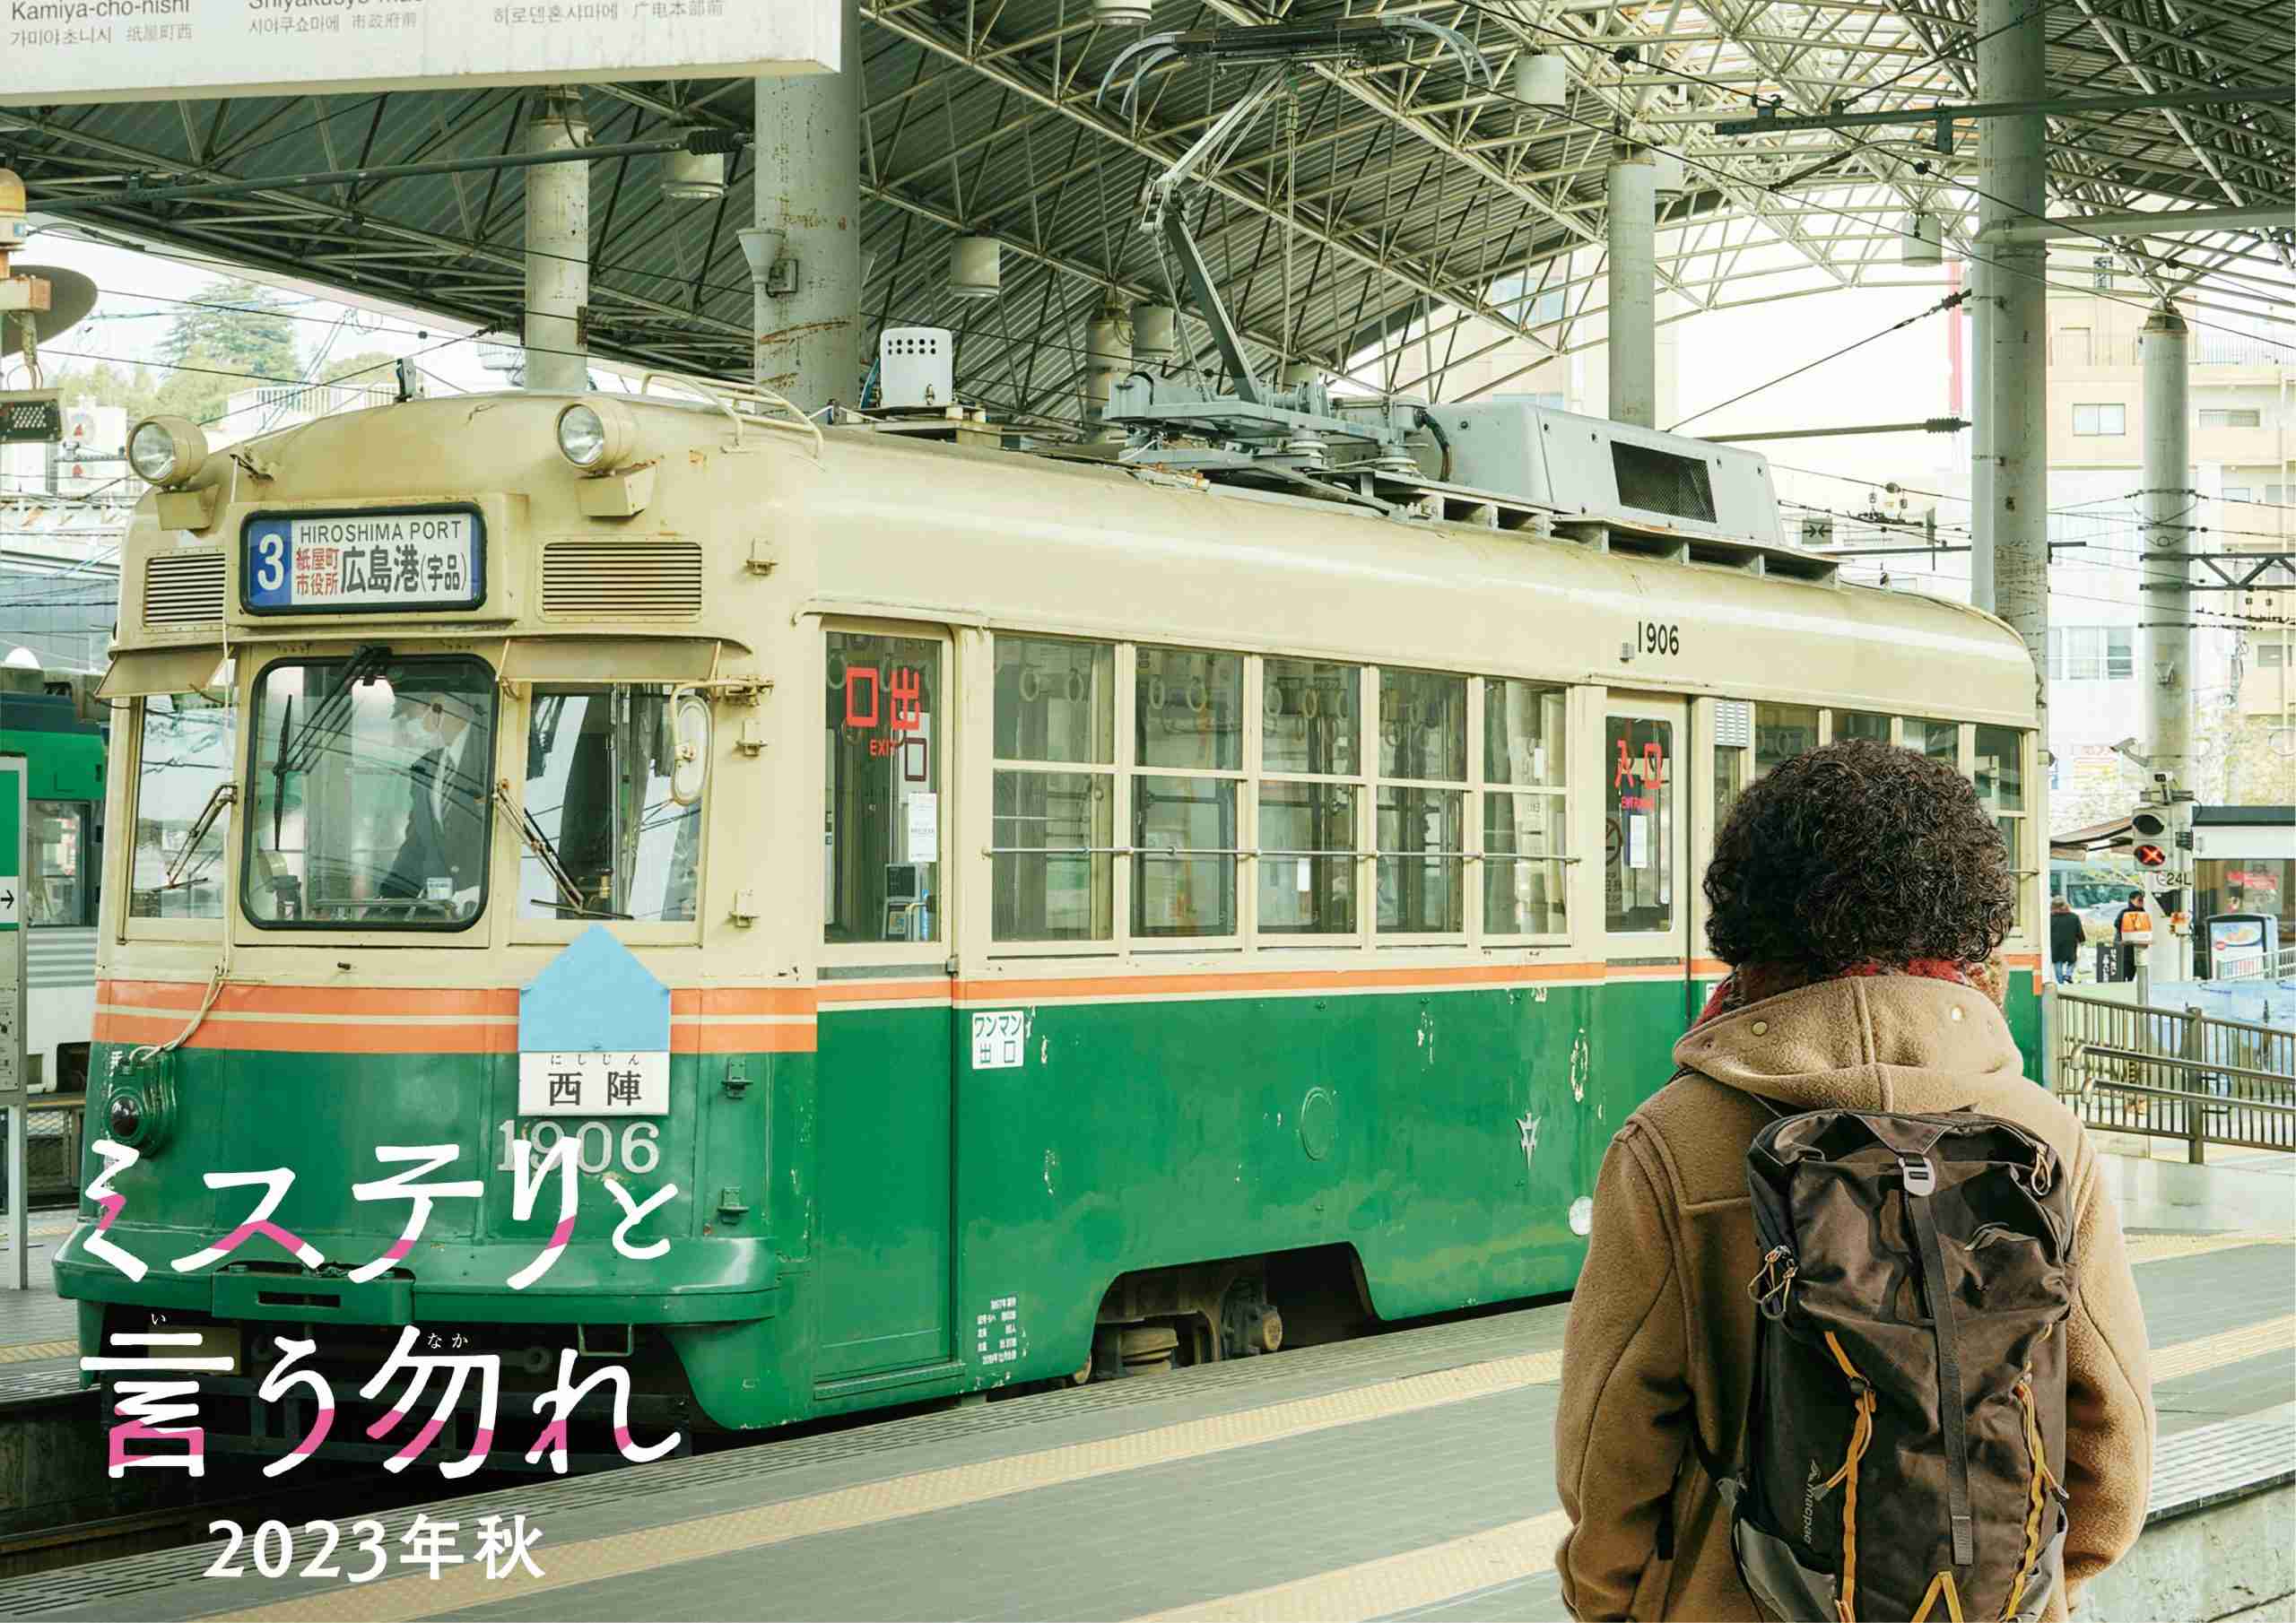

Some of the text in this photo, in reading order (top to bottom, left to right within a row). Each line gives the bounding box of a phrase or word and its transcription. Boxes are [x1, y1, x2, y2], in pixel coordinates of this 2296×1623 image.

[300, 520, 461, 543] HIROSHIMA PORT
[257, 534, 284, 591] 3
[296, 546, 340, 571] 紙屋町
[296, 571, 339, 596] 市役所
[1638, 621, 1680, 655] 1906
[869, 737, 897, 758] EXIT
[975, 1015, 1022, 1037] ワンマン
[979, 1040, 1016, 1063] 出口
[547, 1070, 642, 1107] 西陣
